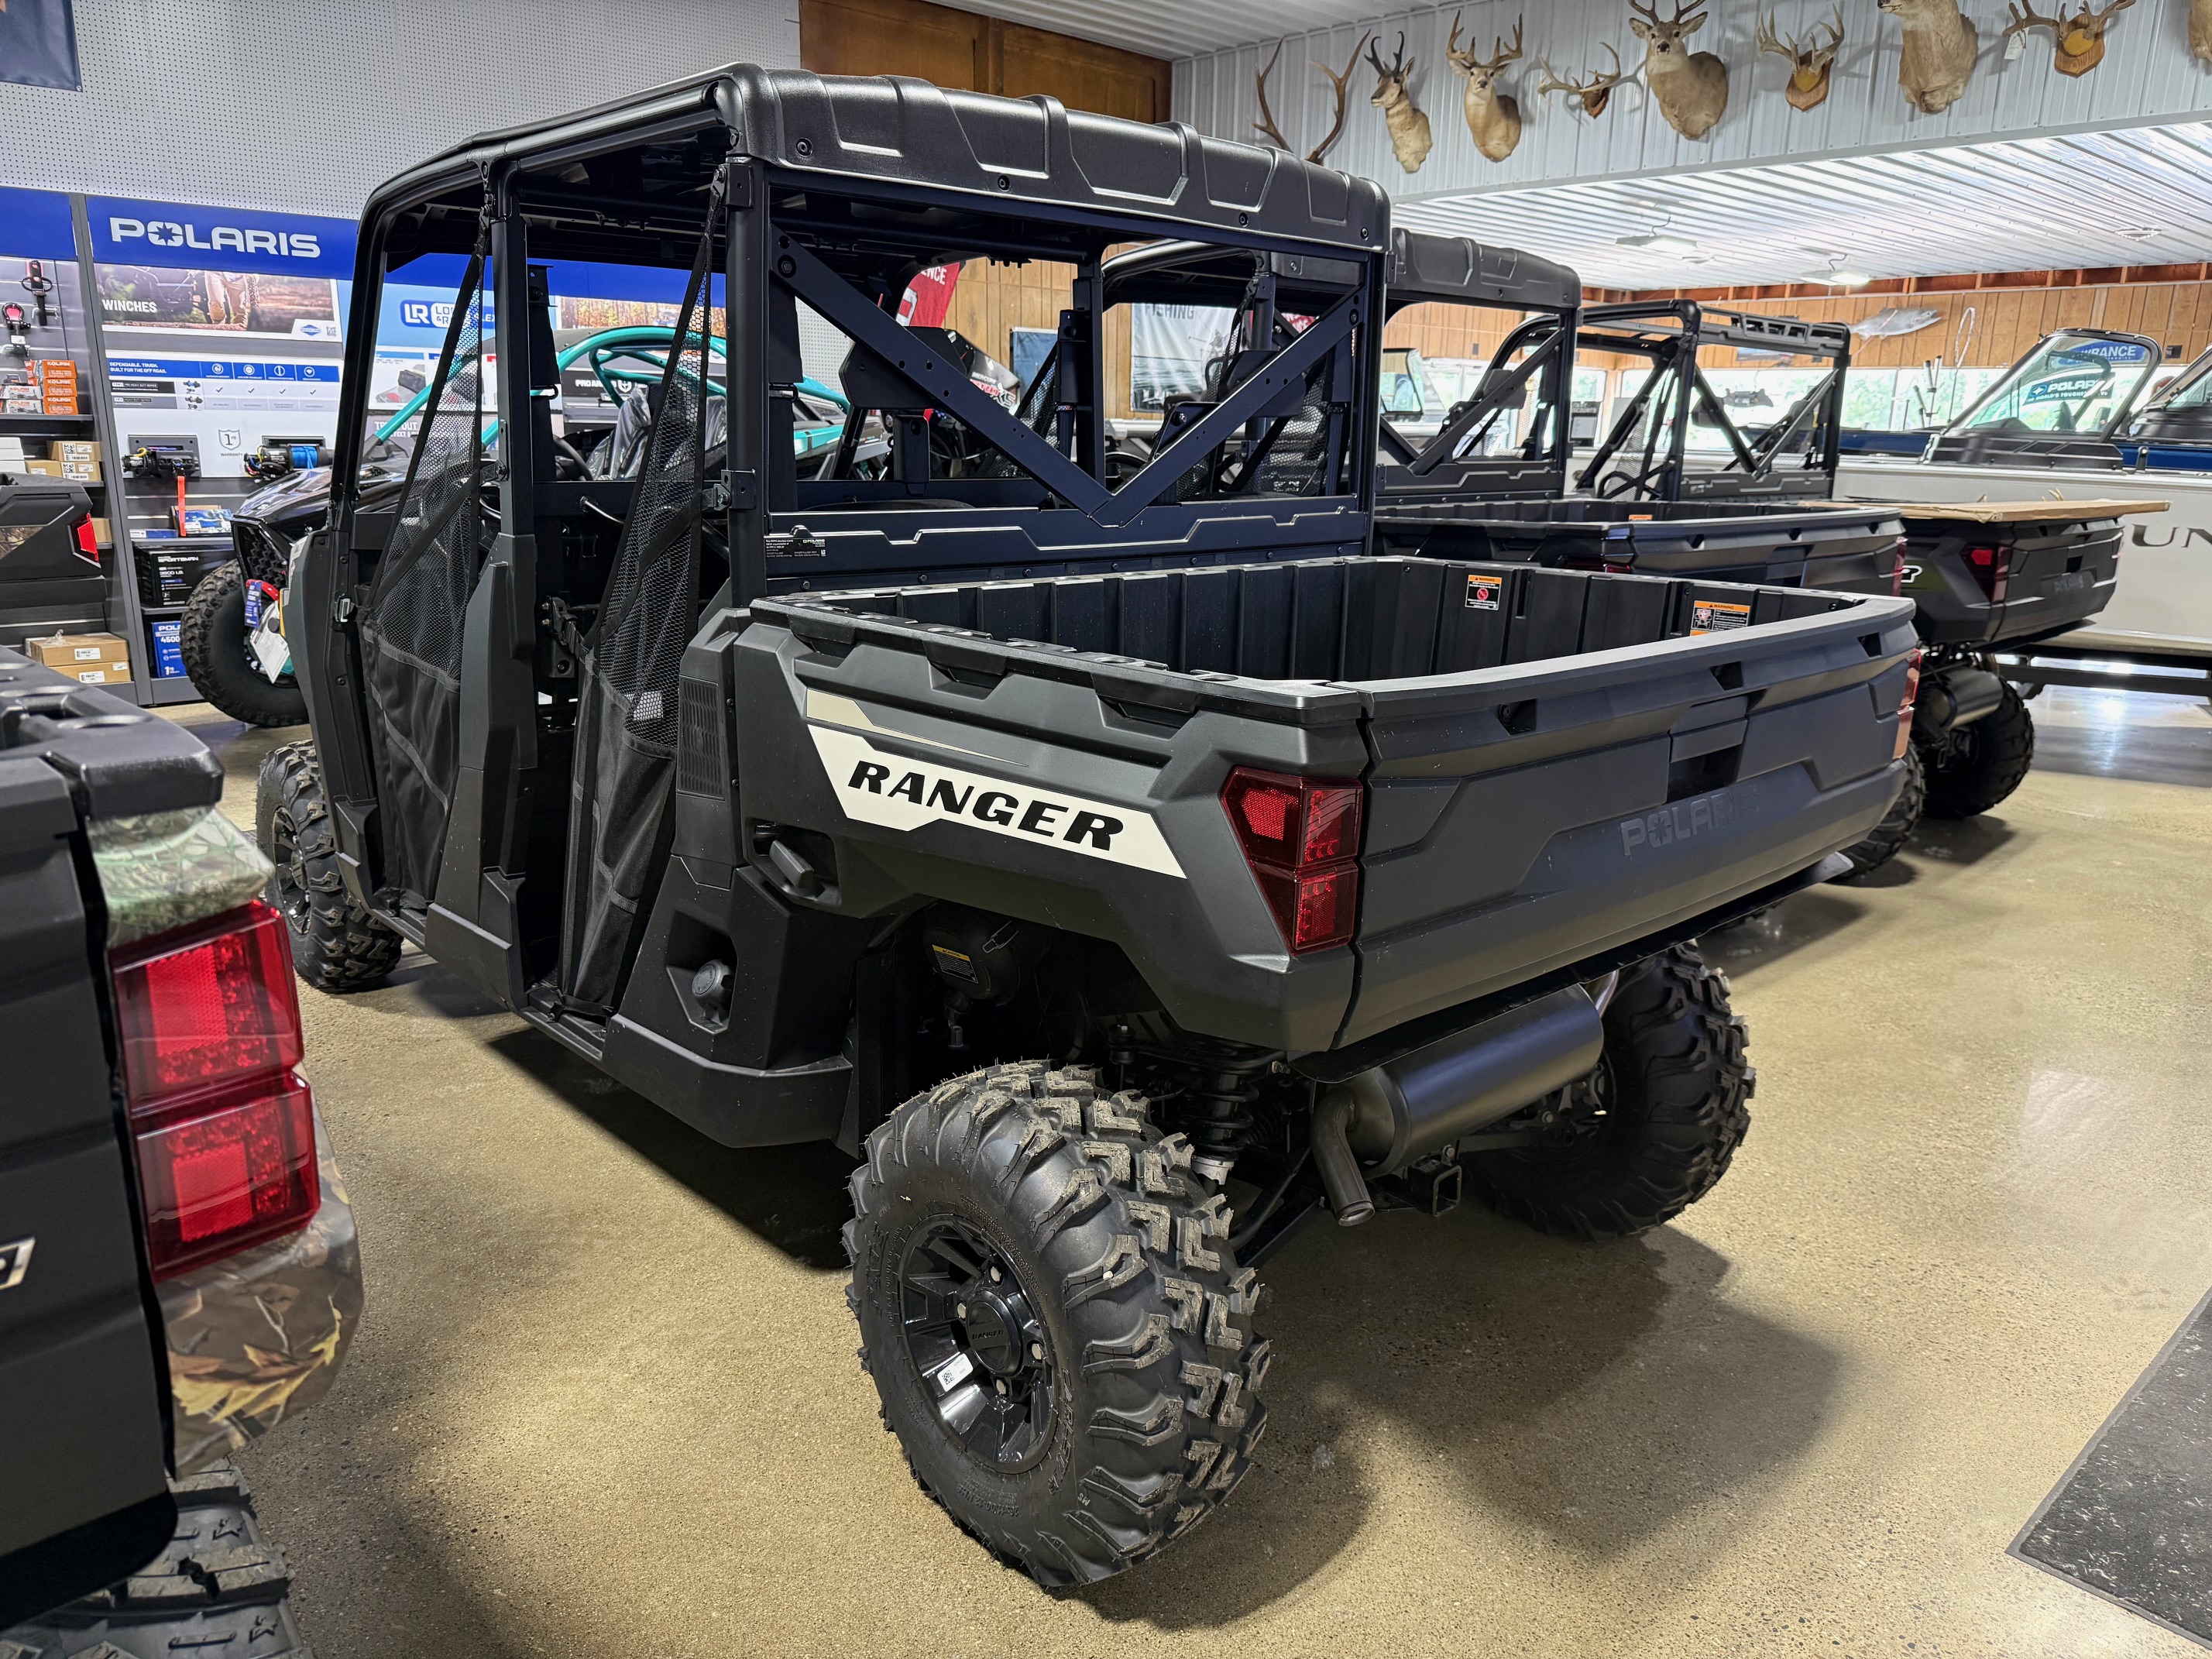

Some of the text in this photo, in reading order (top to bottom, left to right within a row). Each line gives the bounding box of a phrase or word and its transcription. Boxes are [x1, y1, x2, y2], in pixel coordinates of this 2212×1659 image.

[109, 217, 321, 258] POLARIS
[102, 298, 158, 314] WINCHES
[404, 303, 431, 325] LR
[1144, 304, 1195, 320] FISHING
[2047, 380, 2097, 393] POLAR
[2131, 523, 2212, 548] UN
[847, 760, 1124, 851] RANGER
[1620, 784, 1760, 857] POLARIS
[971, 1329, 1004, 1340] RANGER
